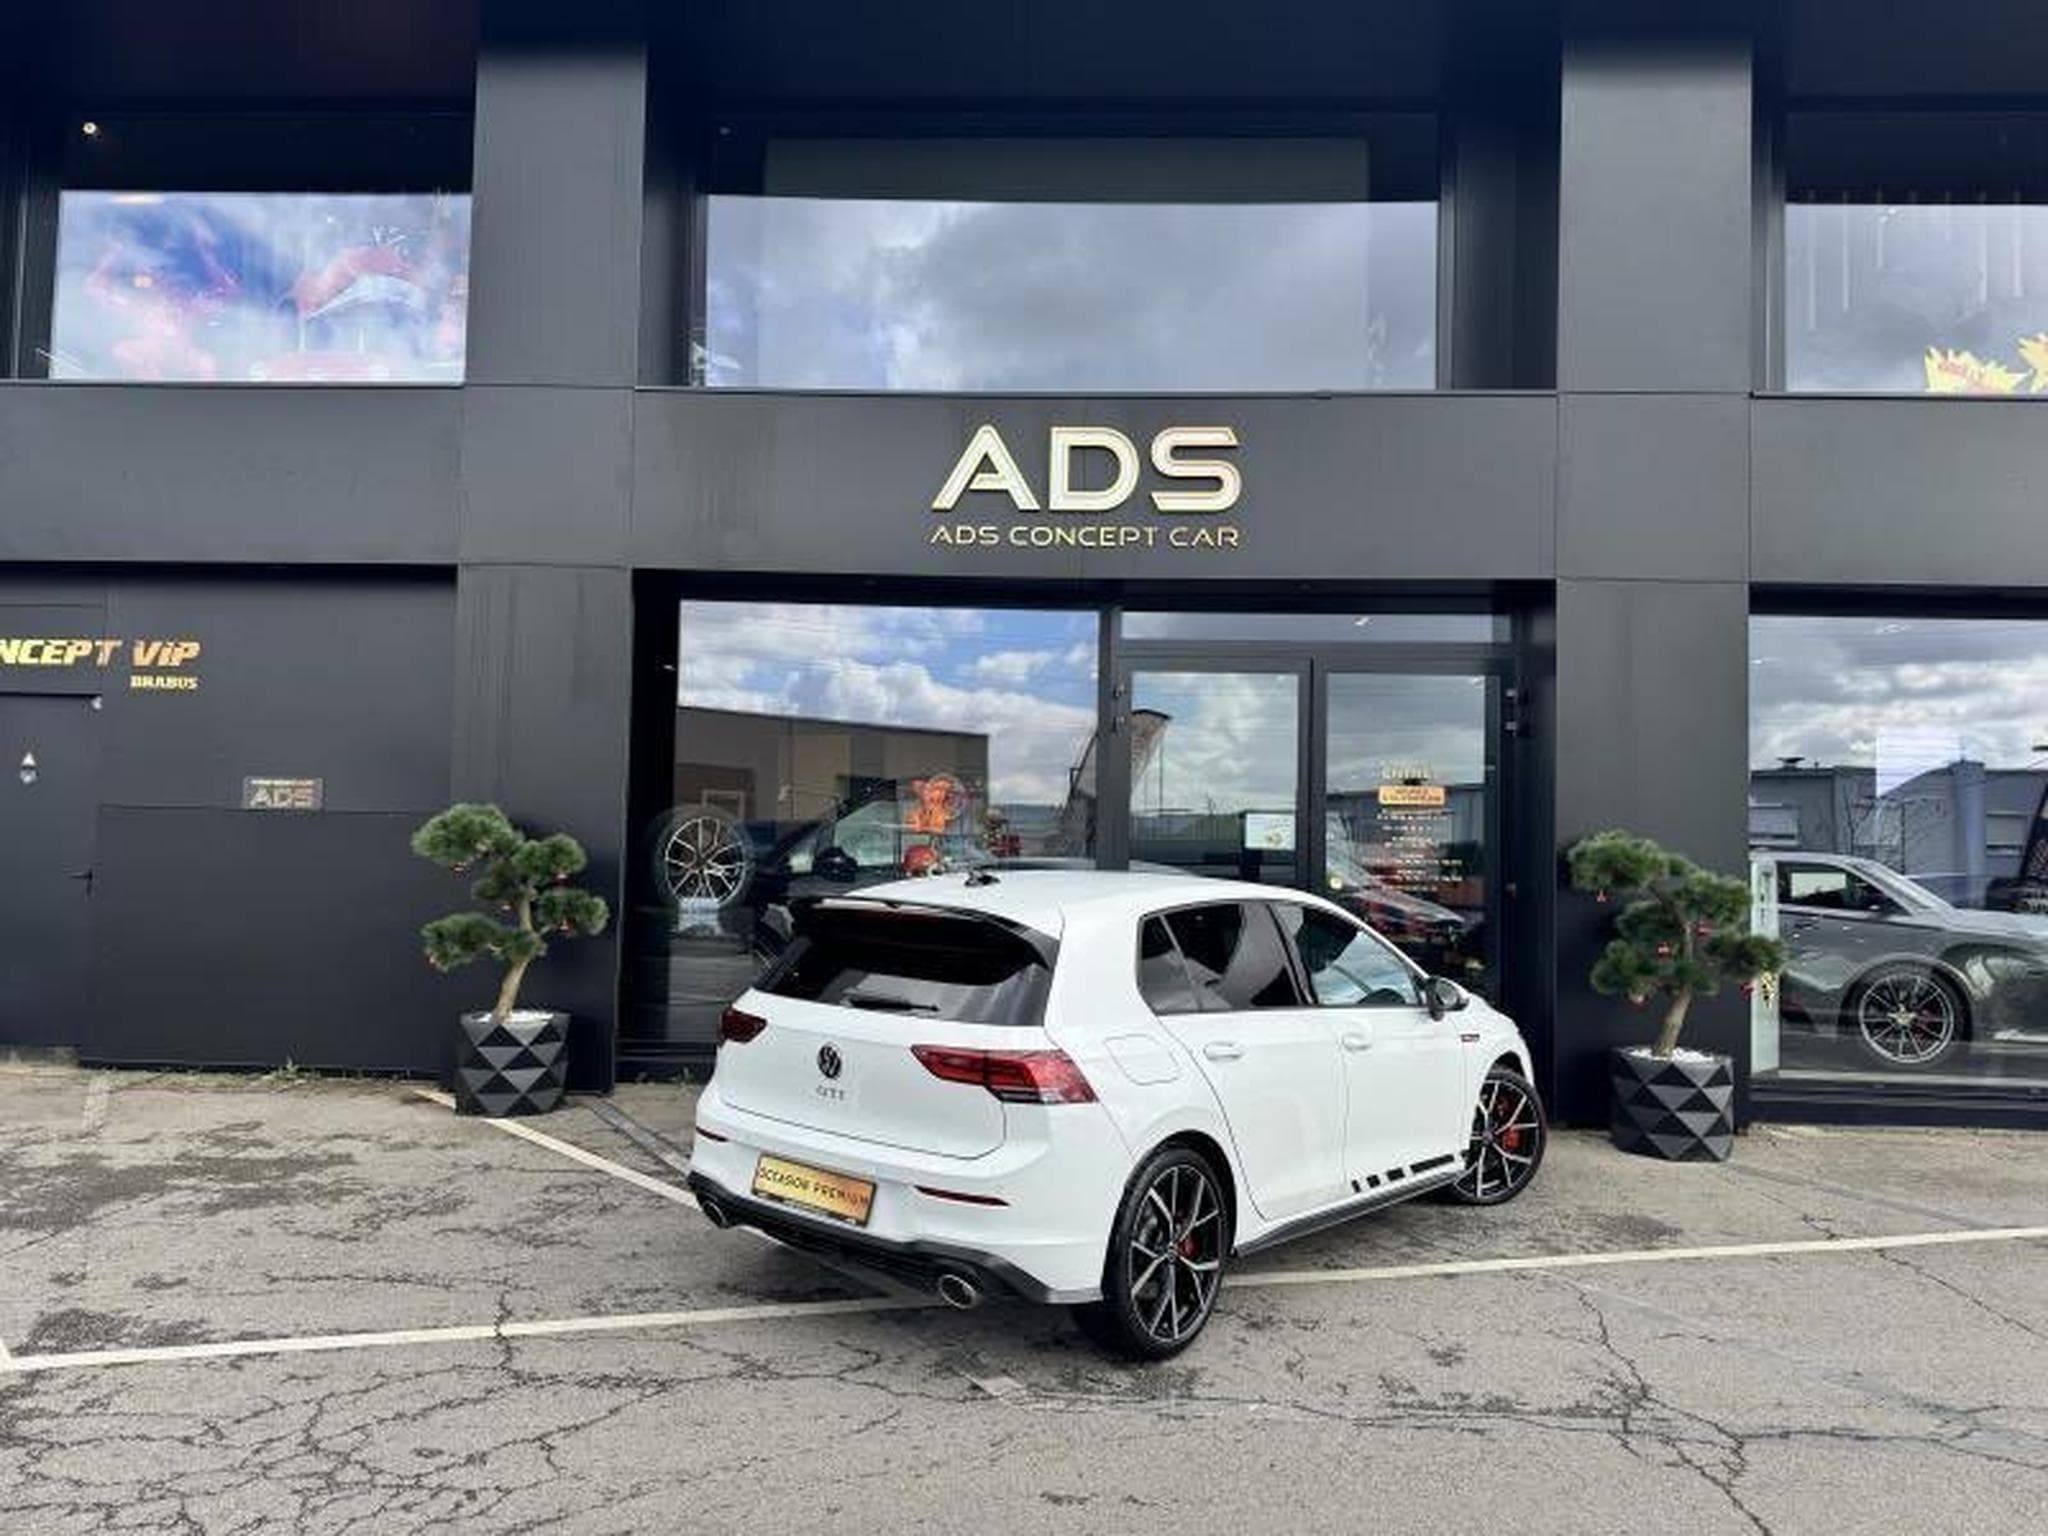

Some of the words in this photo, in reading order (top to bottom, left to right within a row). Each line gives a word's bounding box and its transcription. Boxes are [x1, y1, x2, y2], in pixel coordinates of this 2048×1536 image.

[931, 424, 1242, 511] ADS
[930, 526, 999, 546] ADS
[1009, 526, 1158, 547] CONCEPT
[1169, 527, 1239, 547] CAR
[130, 675, 198, 690] BRABUS
[250, 786, 314, 808] ADS
